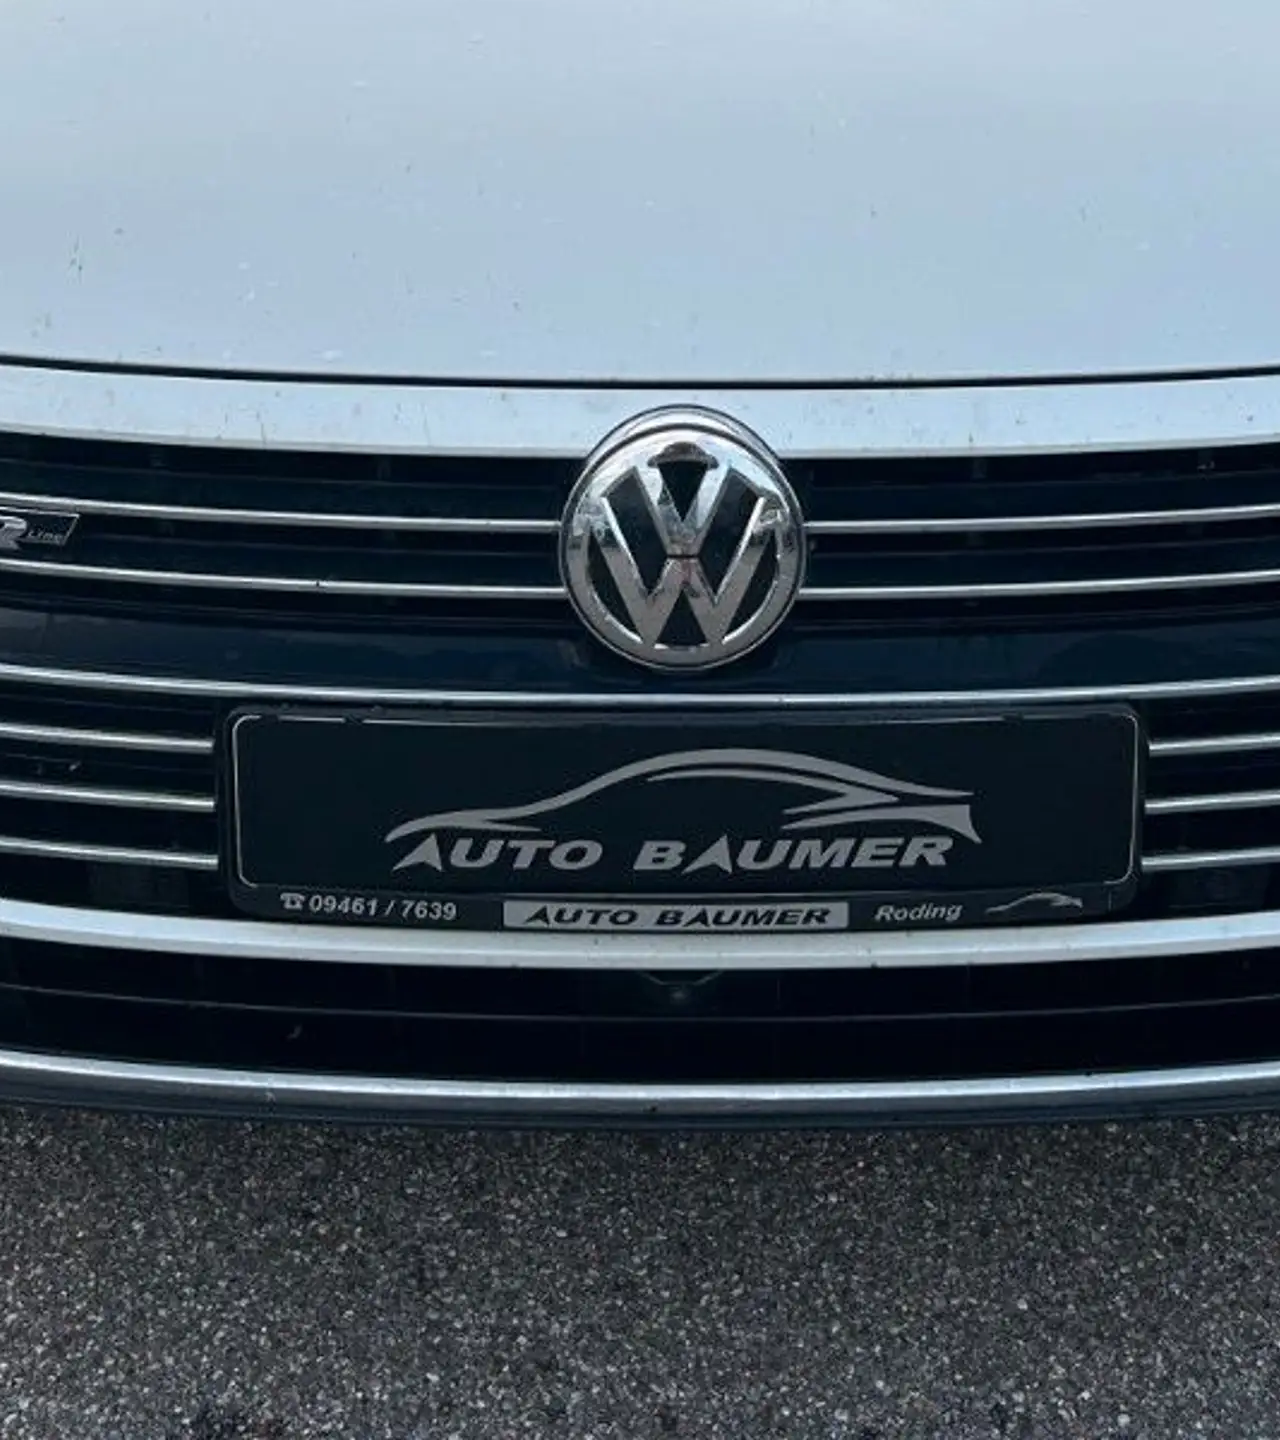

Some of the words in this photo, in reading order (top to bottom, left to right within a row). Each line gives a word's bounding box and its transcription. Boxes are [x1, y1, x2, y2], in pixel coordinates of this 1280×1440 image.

[560, 405, 805, 670] VW
[392, 832, 604, 873] AUTO
[632, 832, 954, 874] BAUMER
[308, 894, 379, 917] 09461
[401, 900, 458, 922] 7639
[523, 905, 639, 926] AUTO
[654, 906, 832, 928] BAUMER
[874, 902, 964, 922] Roding
